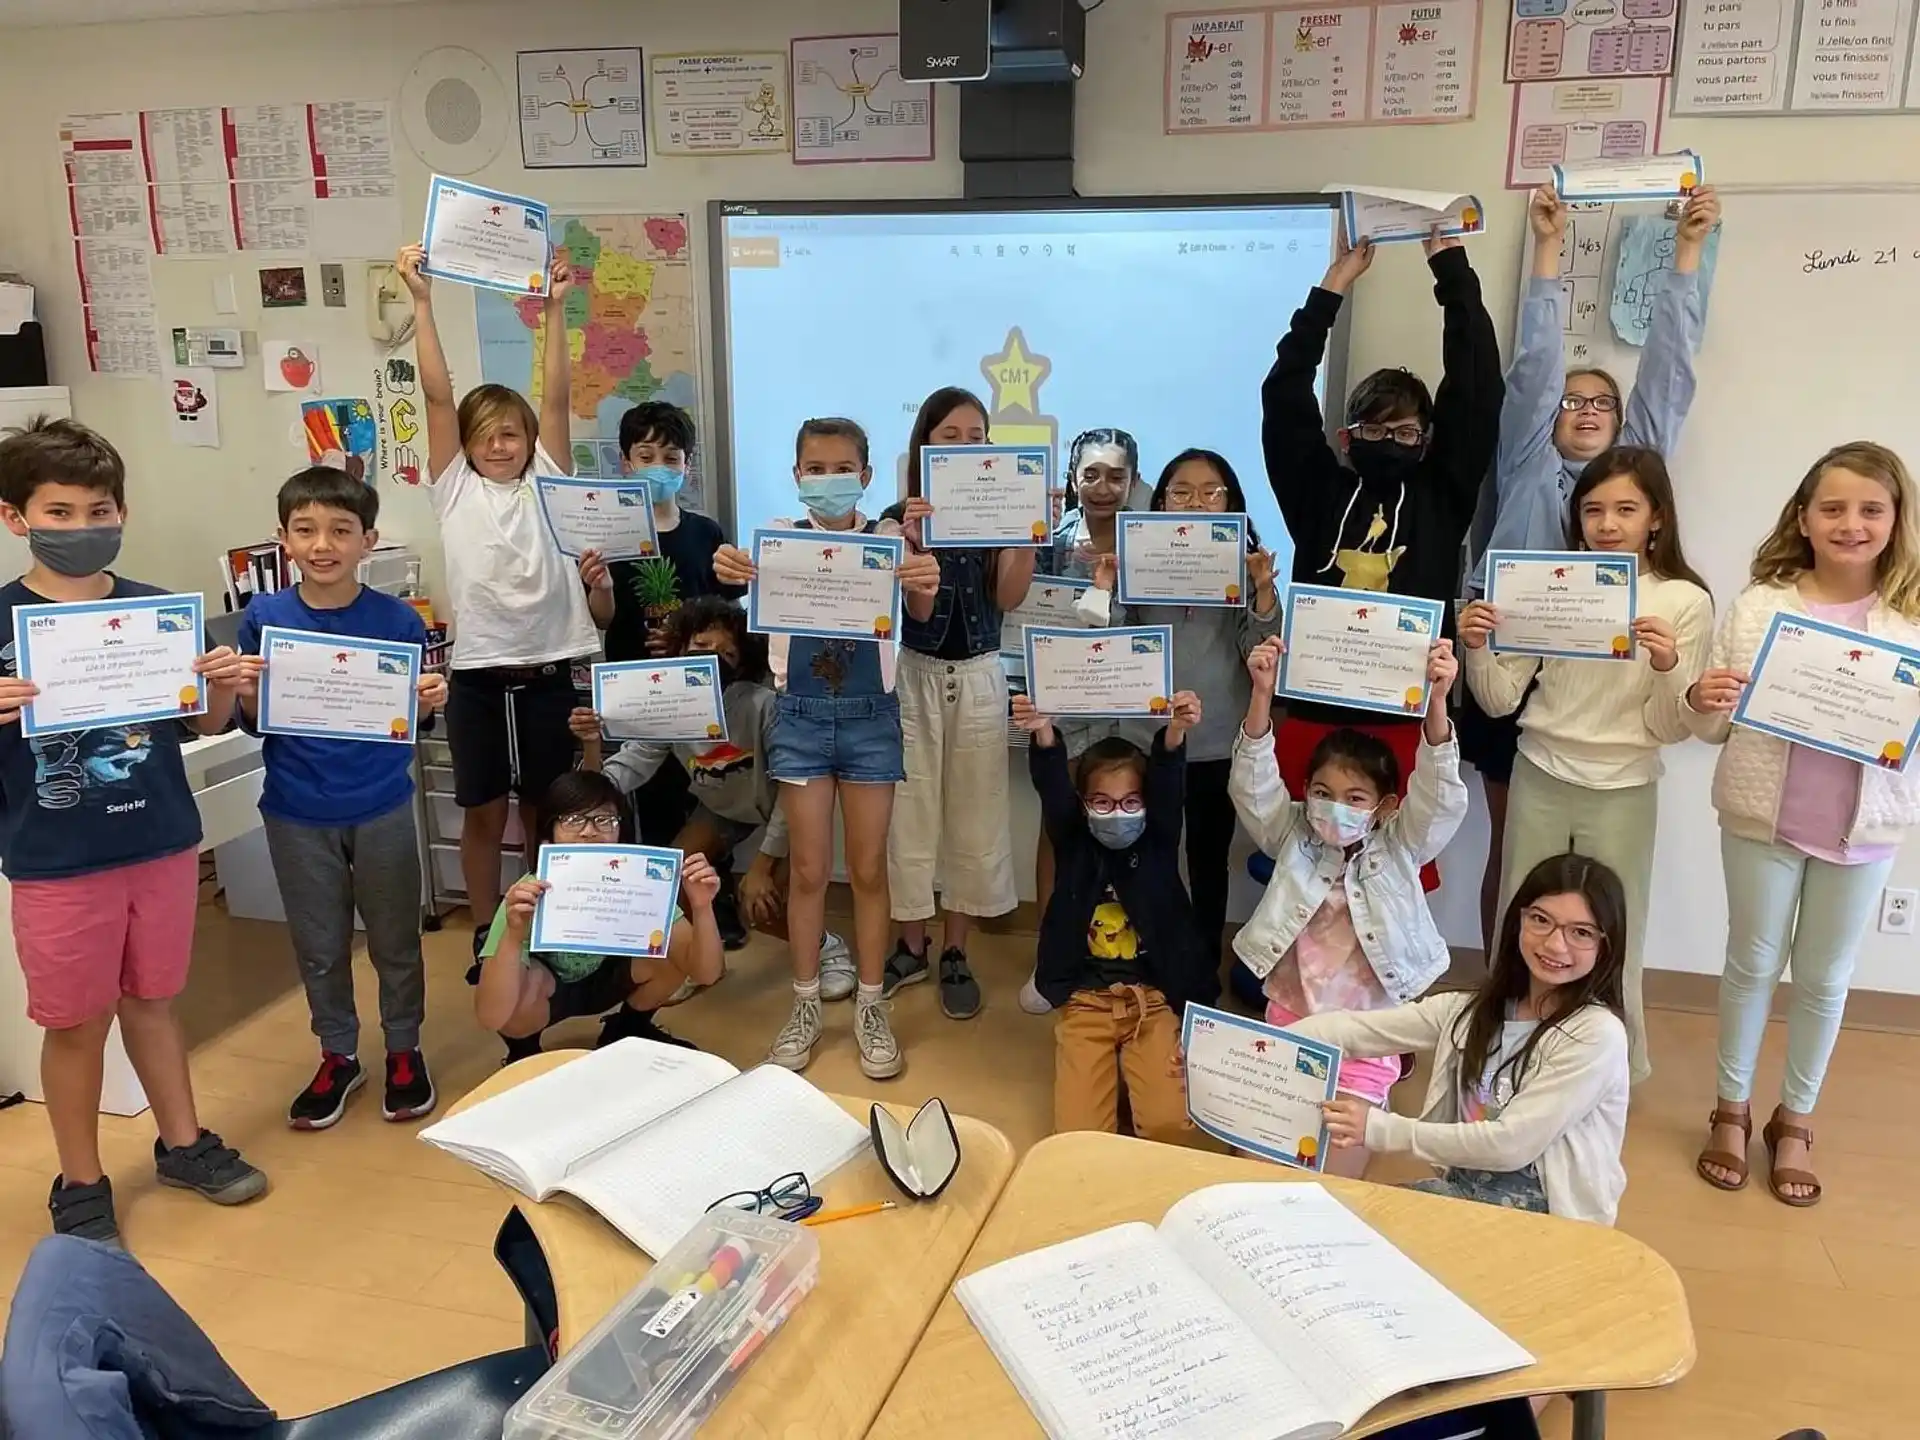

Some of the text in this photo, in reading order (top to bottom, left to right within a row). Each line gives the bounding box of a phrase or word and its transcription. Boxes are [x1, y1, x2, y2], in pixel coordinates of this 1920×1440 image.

[1411, 8, 1441, 19] FUTUR
[1575, 6, 1615, 19] Le présent
[1705, 3, 1741, 14] je pars
[1300, 15, 1342, 25] PRESENT
[1820, 17, 1856, 27] tu finis
[1192, 20, 1244, 32] IMPARFAIT
[1703, 21, 1740, 31] tu pars
[1741, 39, 1762, 50] part
[1871, 36, 1892, 46] finit
[926, 56, 960, 67] SMART
[1698, 57, 1767, 66] nous partons
[1815, 53, 1889, 62] nous finissons
[1696, 75, 1758, 85] vous partez
[1813, 72, 1880, 81] vous finissez
[1725, 93, 1762, 103] partent
[1842, 90, 1884, 99] finissent
[1803, 249, 1861, 273] Lundi
[1874, 247, 1896, 264] 21
[1000, 369, 1030, 384] CM1
[374, 369, 383, 399] brain?
[378, 404, 386, 423] your
[762, 540, 783, 548] aefe
[1296, 596, 1316, 605] aefe
[30, 617, 56, 628] aefe
[1780, 625, 1805, 637] aefe
[1194, 1017, 1215, 1029] aefe
